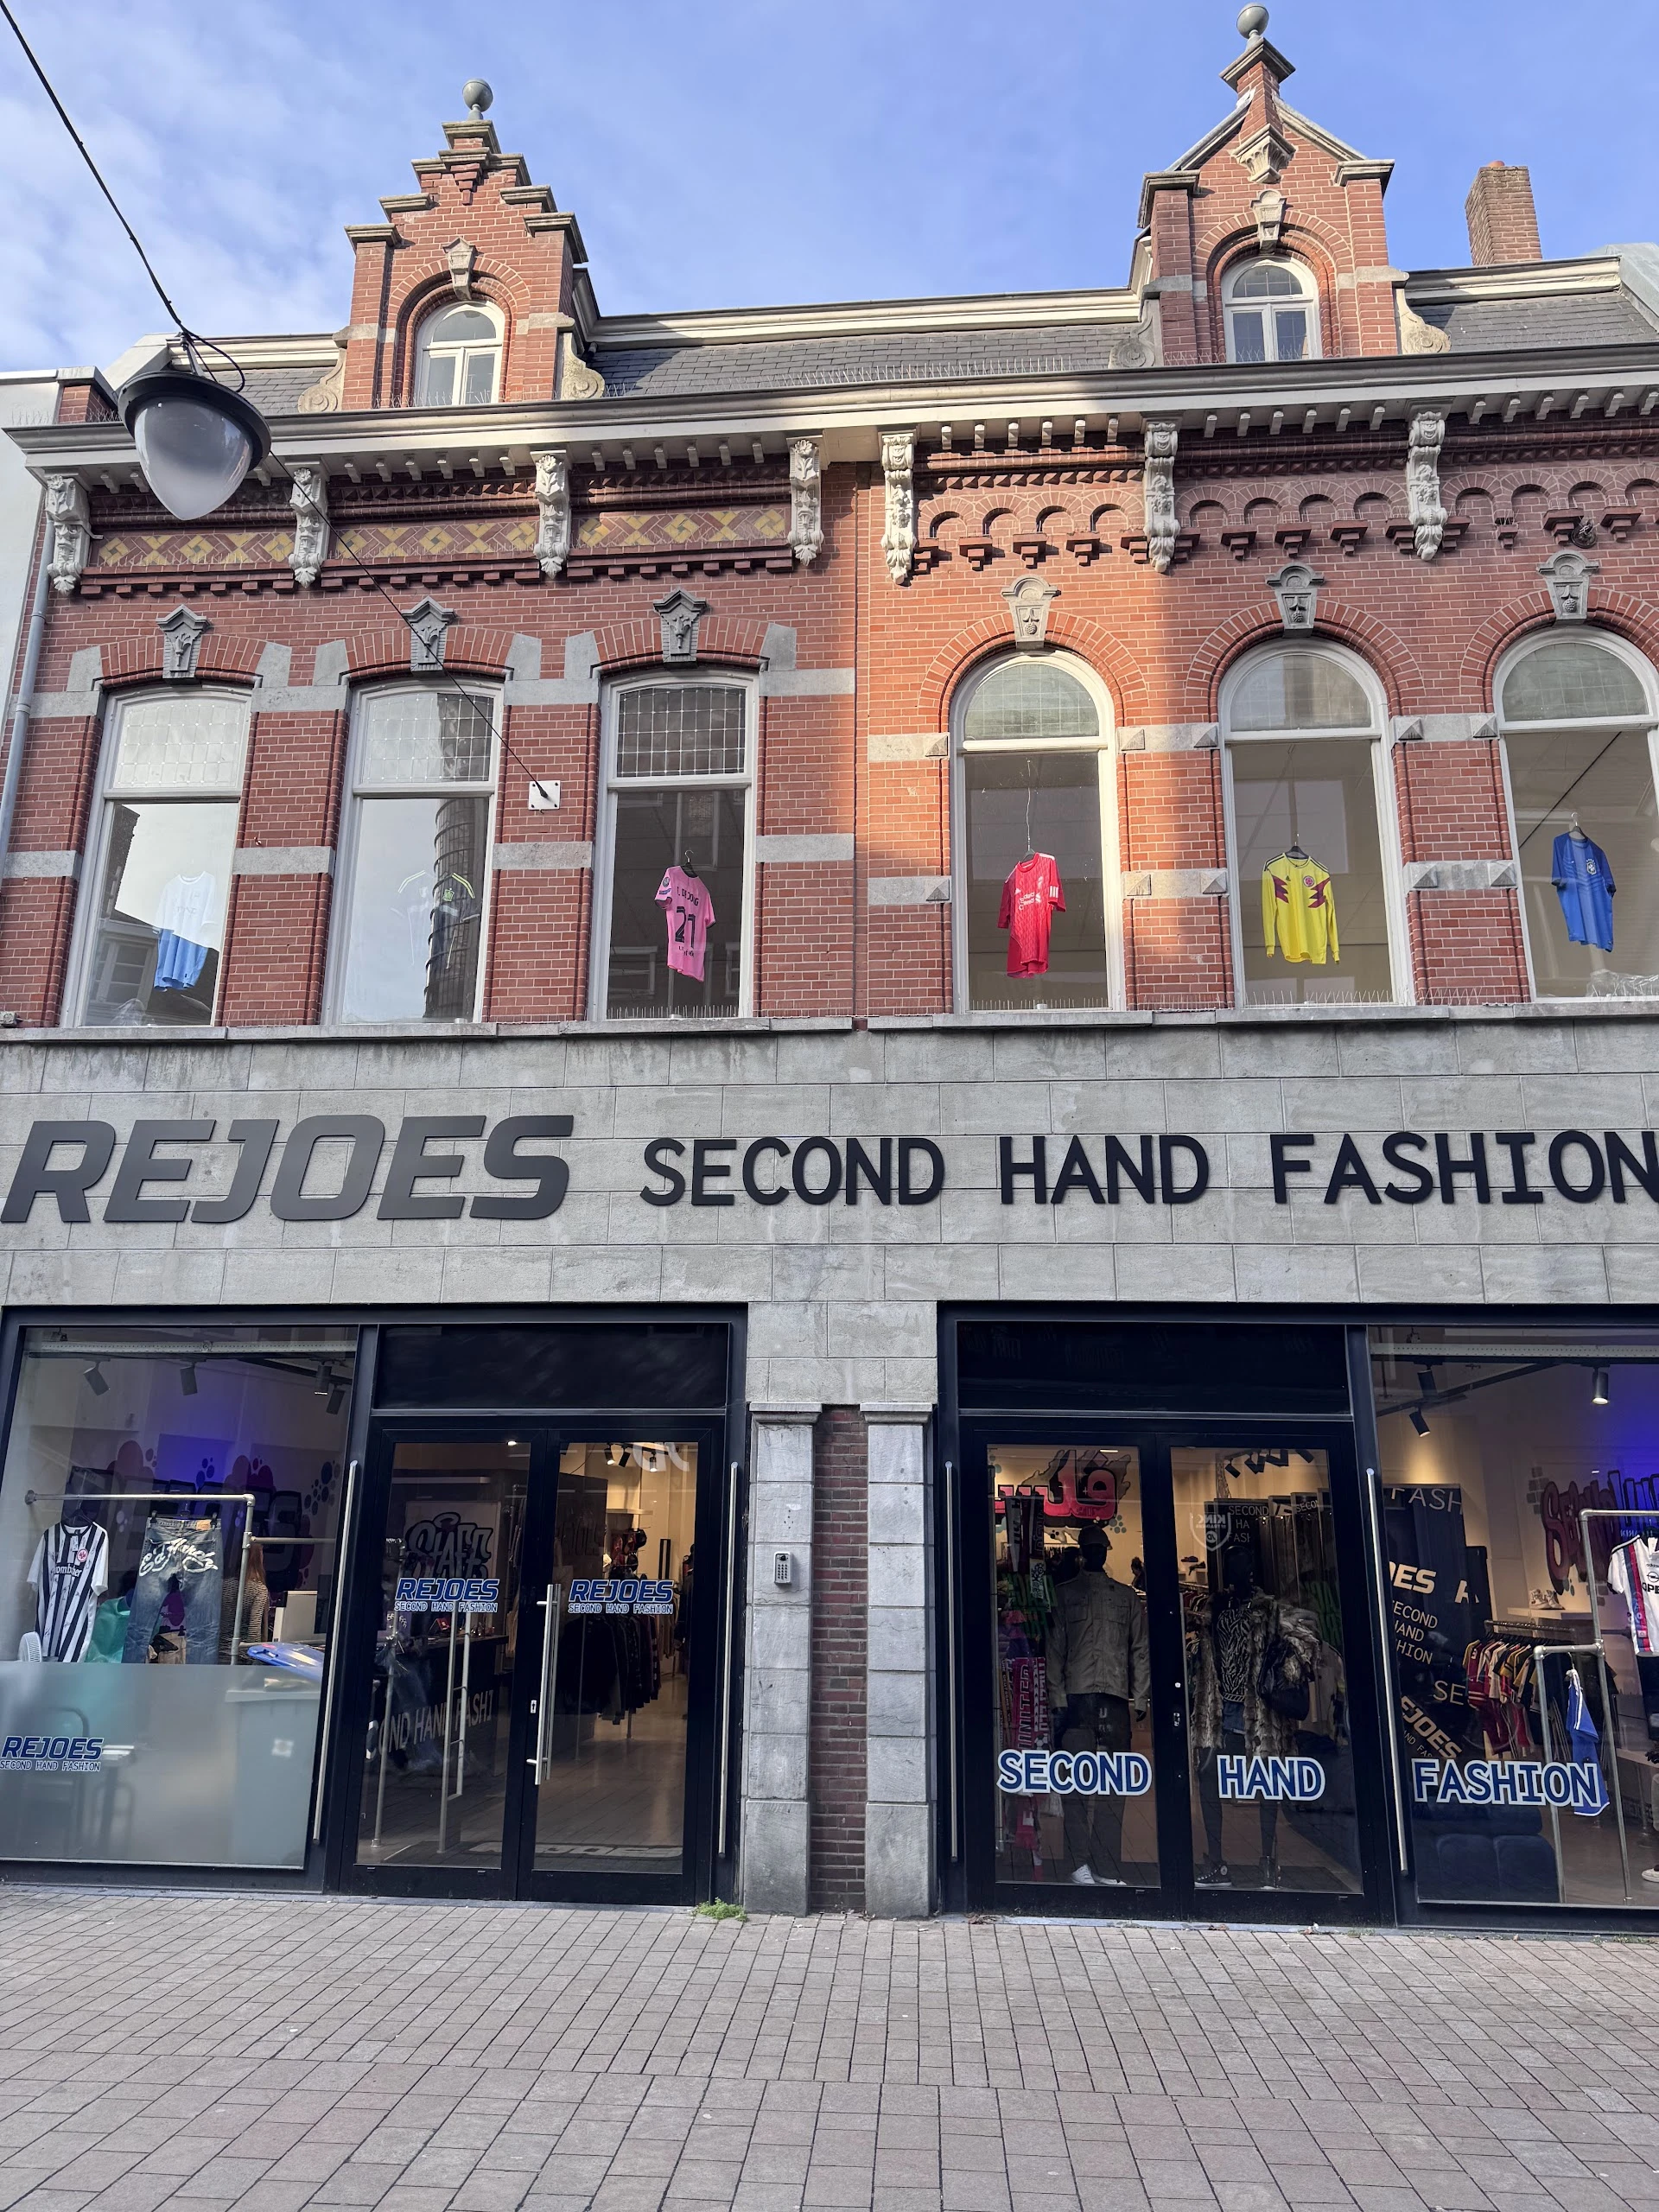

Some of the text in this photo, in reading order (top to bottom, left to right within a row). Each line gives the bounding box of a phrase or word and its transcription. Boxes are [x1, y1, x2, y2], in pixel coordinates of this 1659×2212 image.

[675, 906, 696, 949] 21
[2, 1114, 575, 1223] REJOES
[639, 1130, 1659, 1205] SECOND HAND FASHION
[1228, 1505, 1269, 1516] SECOND
[1296, 1499, 1318, 1513] SECO
[395, 1578, 500, 1602] REJOES
[569, 1579, 674, 1603] REJOES
[394, 1601, 499, 1613] SECOND HAND FASHION
[568, 1603, 674, 1615] SECOND HAND FASHION
[1392, 1599, 1438, 1629] ECOND
[1396, 1639, 1433, 1665] HION
[1, 1735, 105, 1761] REJOES
[0, 1759, 101, 1772] SECOND HAND FASHION
[996, 1749, 1152, 1796] SECOND
[1217, 1754, 1325, 1801] HAND
[1411, 1758, 1601, 1808] FASHION
